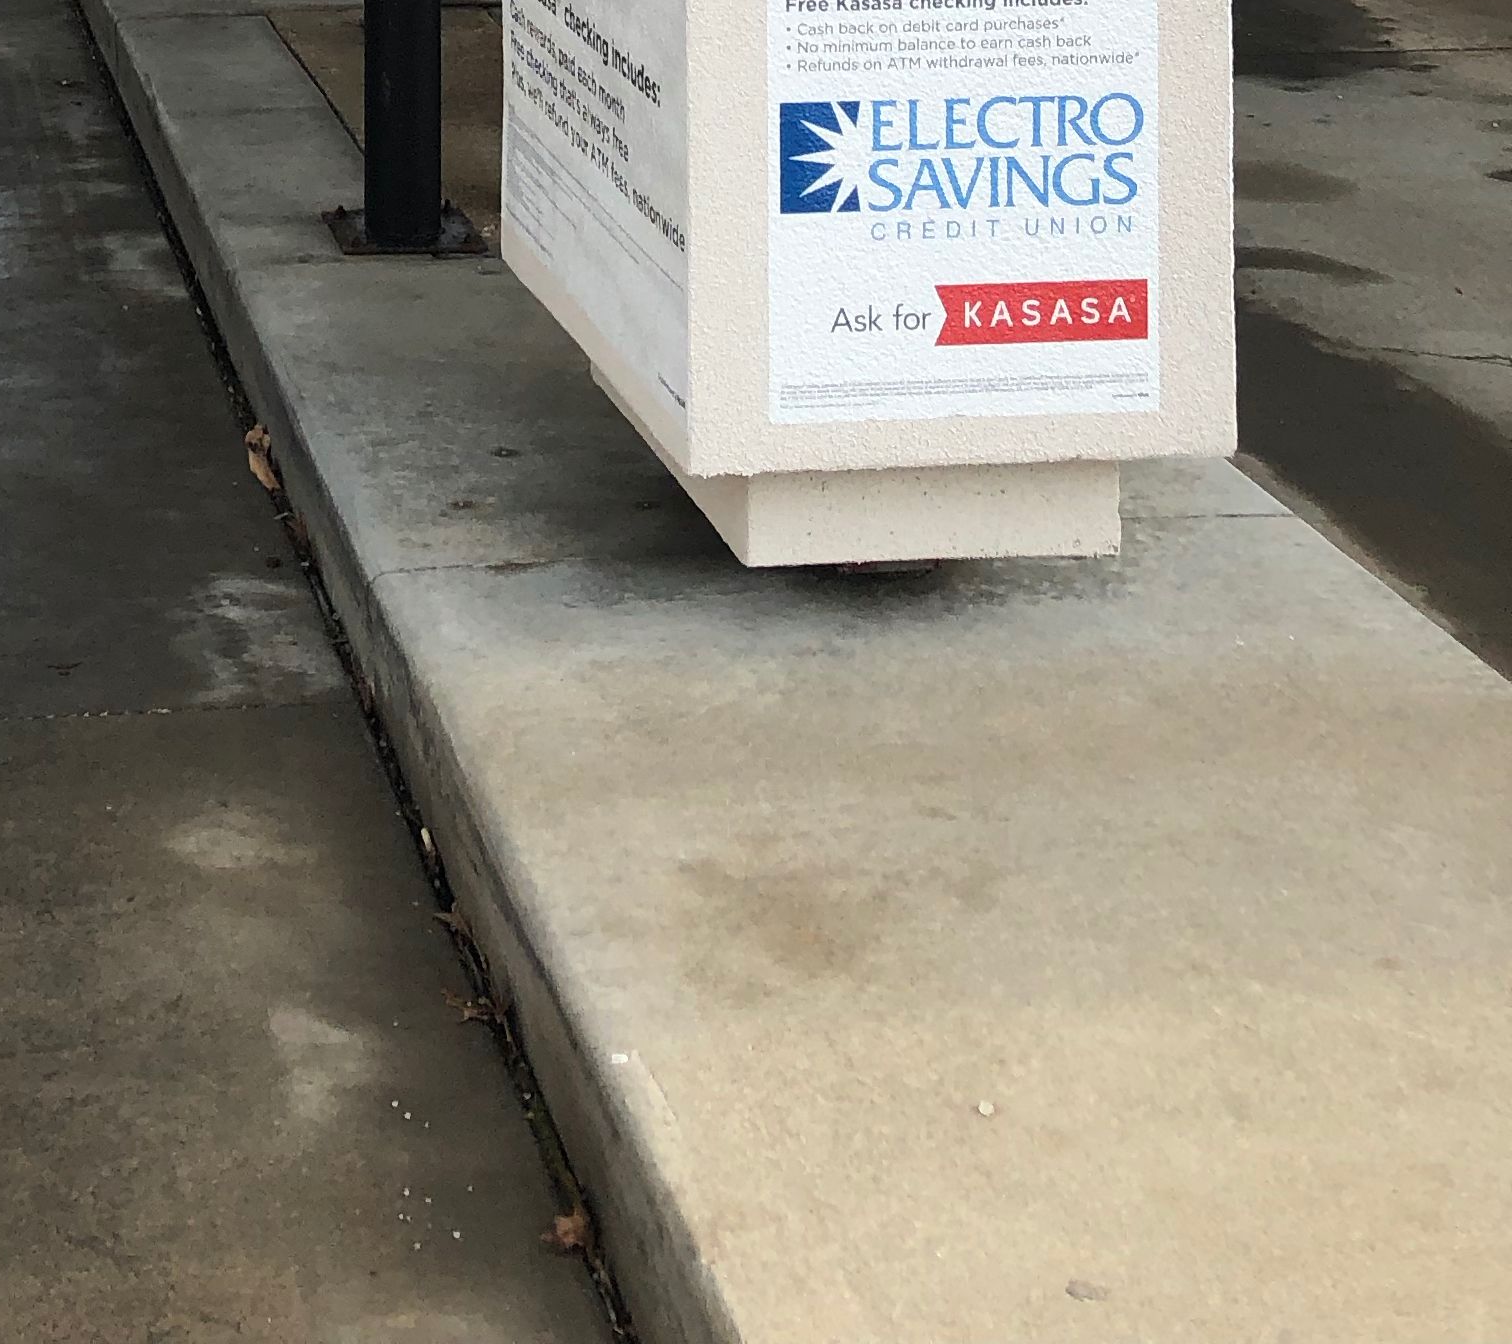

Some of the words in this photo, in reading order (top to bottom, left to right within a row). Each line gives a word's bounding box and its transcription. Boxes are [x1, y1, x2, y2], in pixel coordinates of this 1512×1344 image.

[564, 3, 608, 66] checking
[611, 38, 661, 108] includes:
[797, 22, 834, 35] Cash
[839, 21, 874, 34] back
[879, 23, 898, 33] on
[902, 20, 941, 33] debit
[945, 19, 979, 32] card
[797, 41, 819, 53] No
[823, 40, 893, 53] minimum
[898, 38, 956, 51] balance
[960, 37, 976, 49] to
[980, 38, 1013, 50] earn
[1017, 35, 1051, 48] cash
[1056, 34, 1092, 47] back
[510, 0, 526, 30] Cash
[558, 48, 575, 77] paid
[577, 66, 596, 96] each
[599, 85, 625, 124] month
[797, 58, 859, 72] Refunds
[863, 60, 882, 71] on
[888, 57, 921, 70] ATM
[926, 55, 1008, 68] withdrawal
[1013, 54, 1047, 67] fees,
[511, 29, 524, 60] Free
[526, 48, 557, 97] checking
[613, 126, 628, 162] free
[871, 92, 1144, 152] ELECTRO
[570, 125, 588, 156] your
[591, 143, 609, 179] ATM
[632, 187, 685, 253] nationwide
[868, 152, 1138, 211] SAVINGS
[871, 219, 1002, 241] CREDIT
[1025, 215, 1133, 236] UNION
[831, 306, 883, 332] Ask
[892, 304, 932, 331] for
[963, 296, 1133, 328] KASASA
